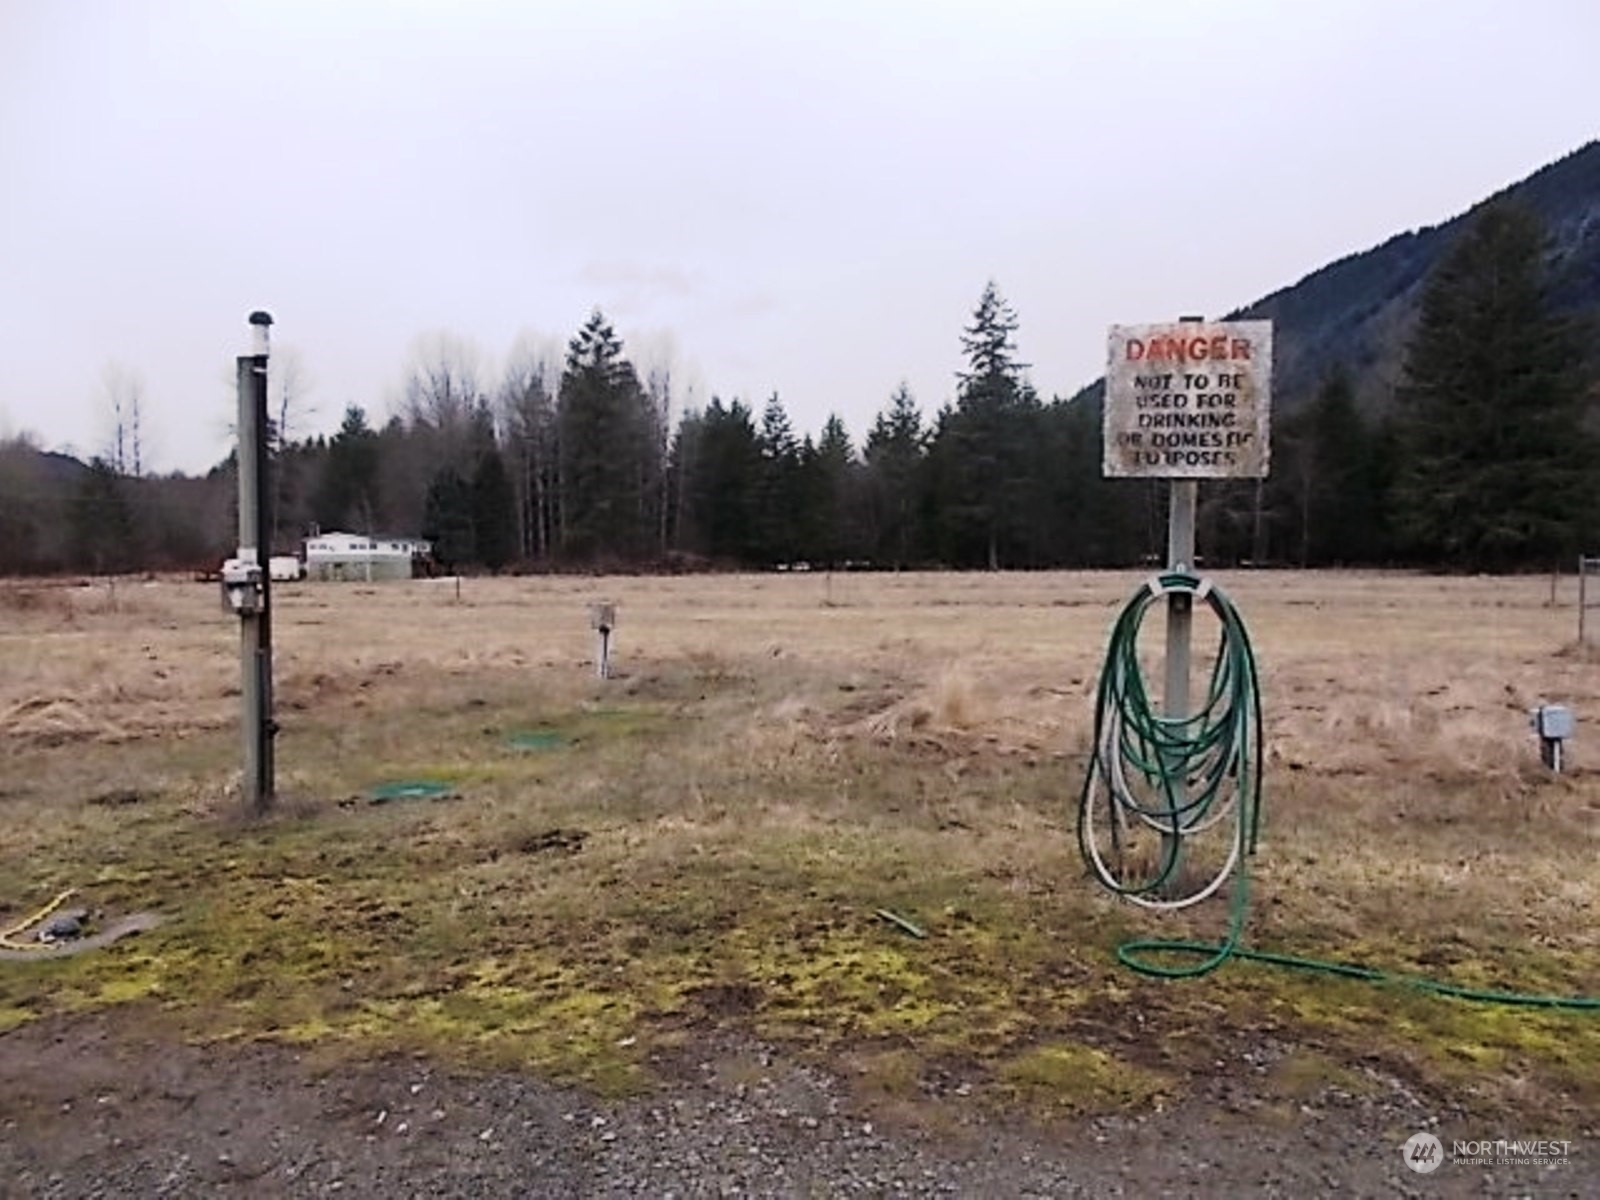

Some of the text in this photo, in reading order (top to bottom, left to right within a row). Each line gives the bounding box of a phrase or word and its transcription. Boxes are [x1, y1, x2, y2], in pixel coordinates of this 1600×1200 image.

[1125, 337, 1251, 362] DANGER
[1134, 374, 1172, 390] NOT
[1184, 374, 1209, 390] TO
[1136, 394, 1236, 409] USED FOR
[1138, 413, 1236, 428] DRINKING
[1117, 432, 1143, 446] OR
